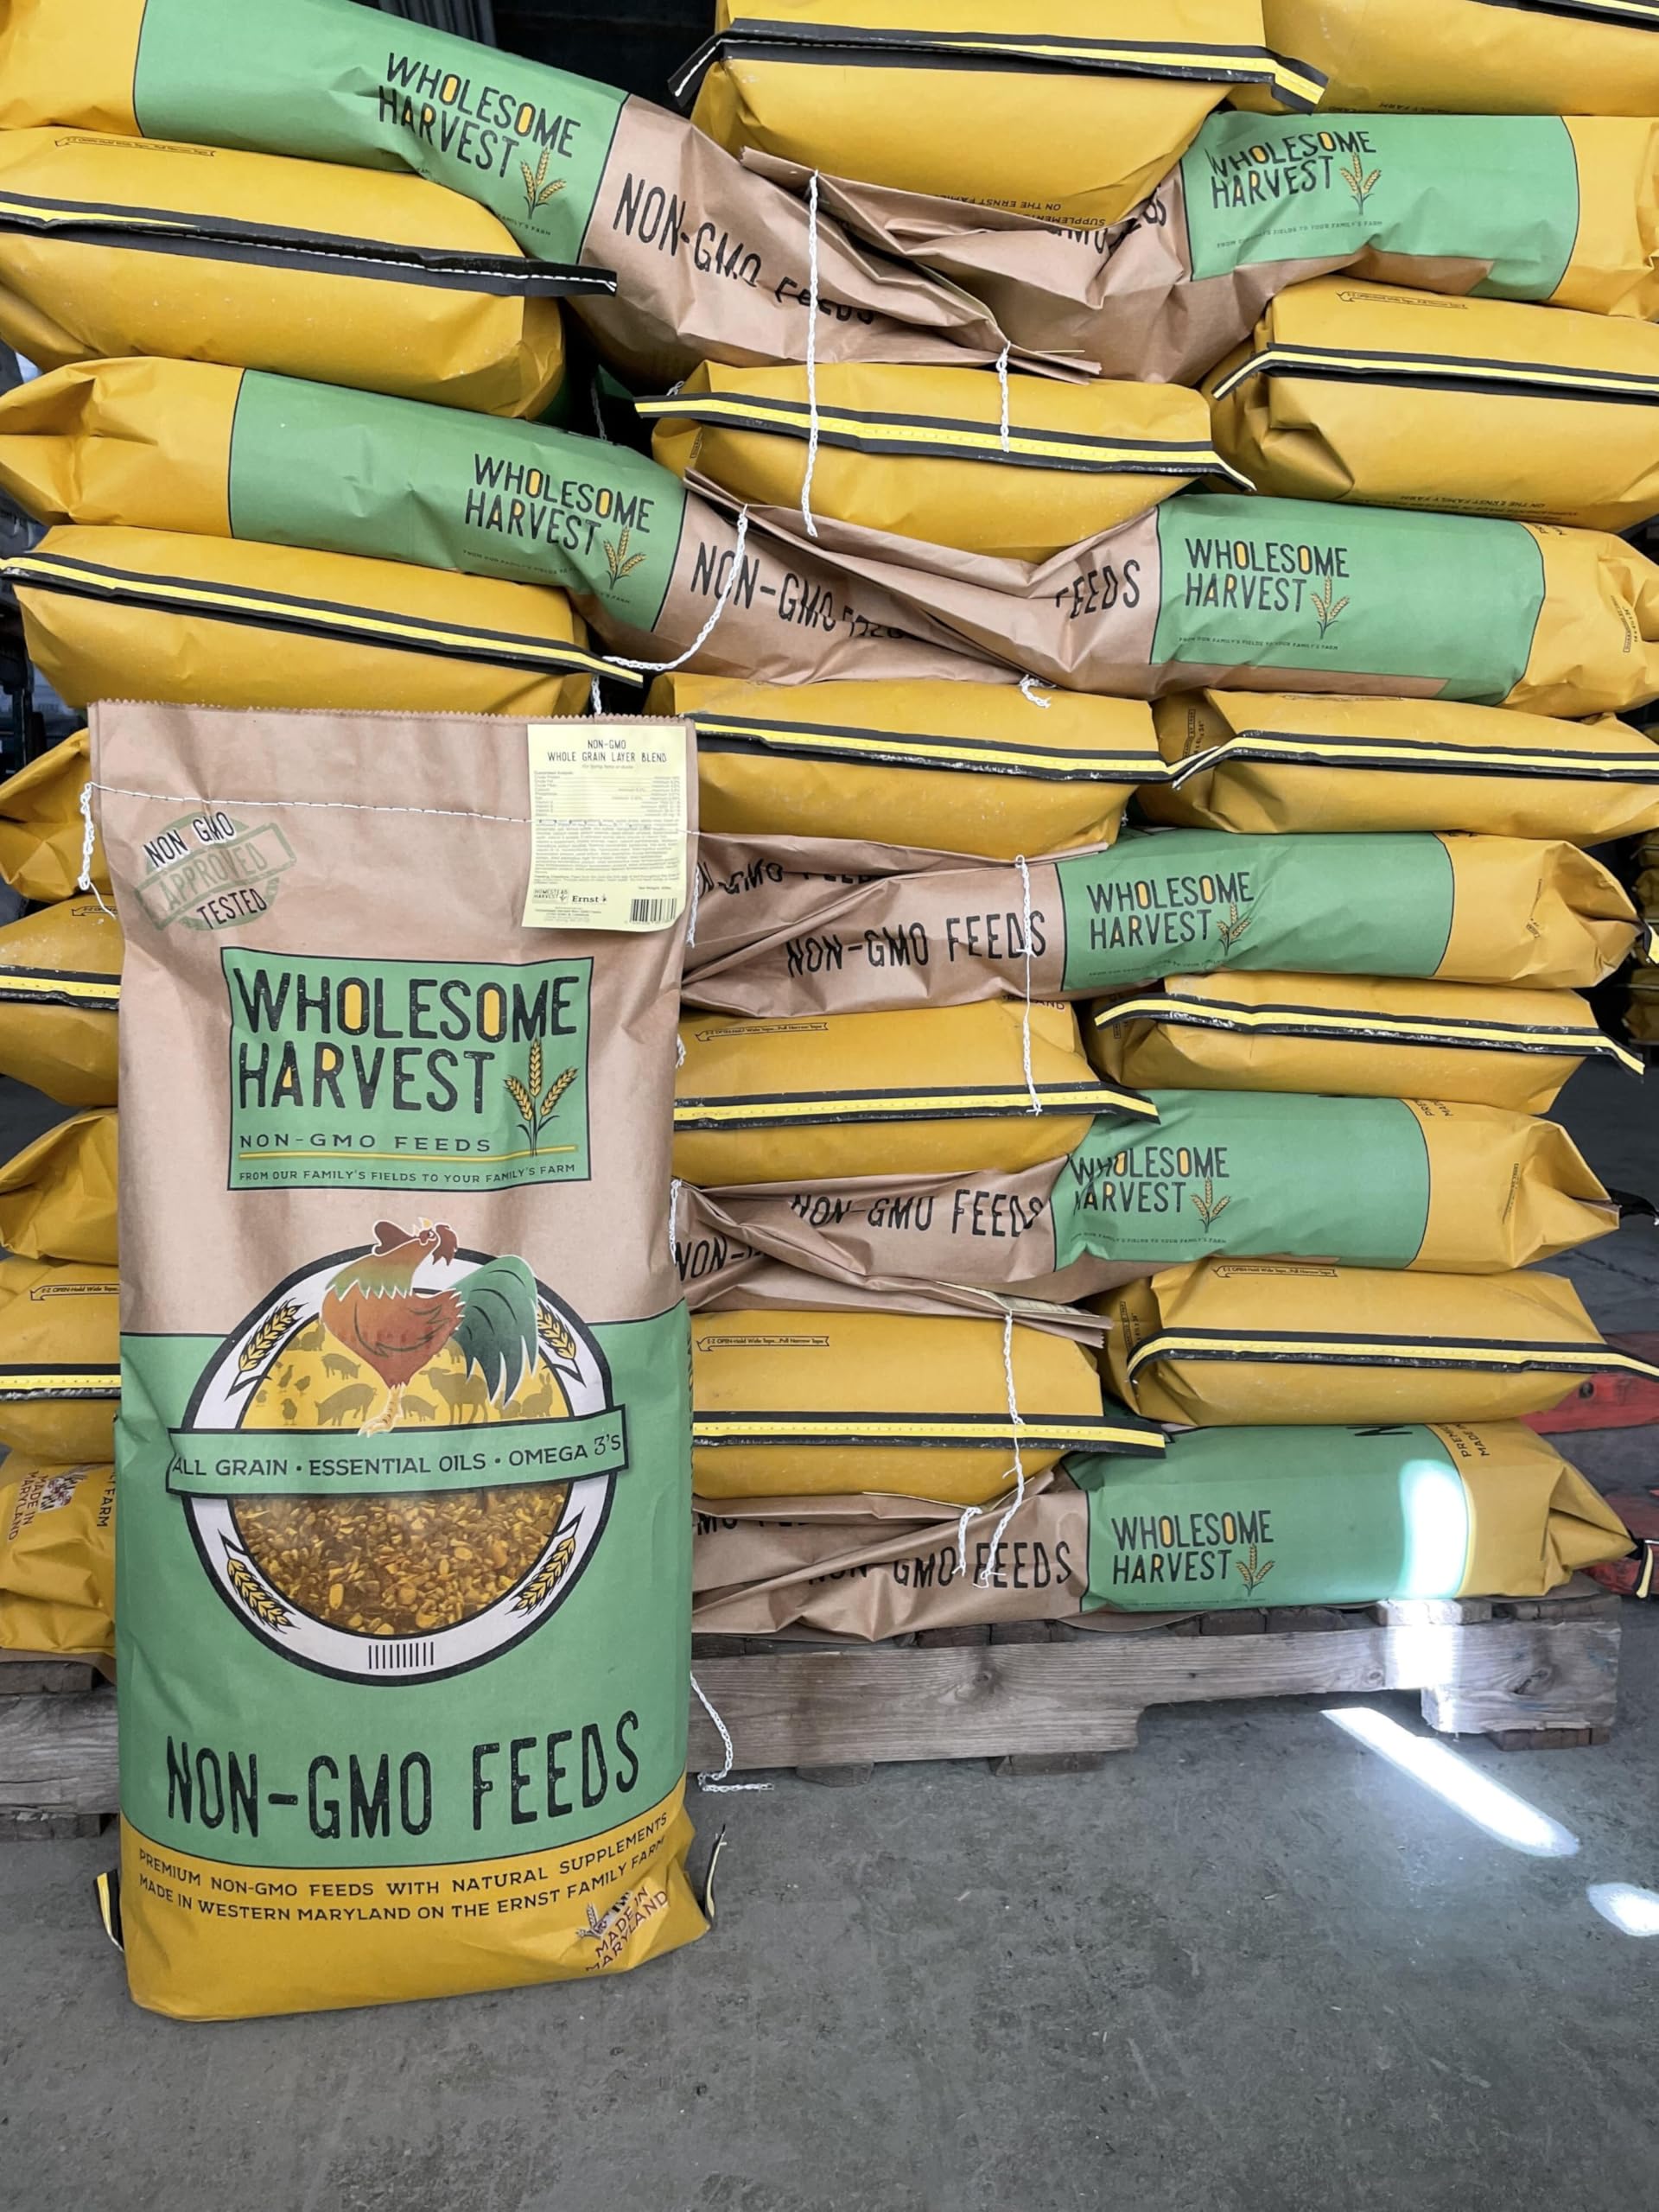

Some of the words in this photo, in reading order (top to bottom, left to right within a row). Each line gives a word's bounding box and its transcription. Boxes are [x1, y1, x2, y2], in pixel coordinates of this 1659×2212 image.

[387, 53, 581, 158] WHOLESOME
[378, 85, 519, 178] HARVEST
[1204, 131, 1376, 177] WHOLESOME
[1211, 156, 1333, 209] HARVEST
[1020, 201, 1042, 211] THE
[474, 454, 654, 533] WHOLESOME
[465, 488, 601, 556] HARVEST
[1185, 537, 1350, 578] WHOLESOME
[1185, 572, 1307, 613] HARVEST
[547, 751, 576, 762] WHOLE
[582, 752, 606, 761] GRAIN
[611, 752, 636, 762] LAYER
[641, 753, 667, 762] BLEND
[588, 740, 626, 749] NON-GMO
[143, 829, 188, 868] NON
[192, 811, 235, 842] GMO
[159, 842, 269, 911] APPROVED
[1086, 872, 1255, 914] WHOLESOME
[196, 888, 268, 930] TESTED
[1090, 909, 1211, 950] HARVEST
[785, 922, 930, 978] NON-GMO
[946, 910, 1046, 962] FEEDS
[232, 967, 580, 1043] WHOLESOME
[238, 1040, 496, 1115] HARVEST
[239, 1133, 376, 1149] NON-GMO
[394, 1135, 492, 1153] FEEDS
[239, 1170, 269, 1181] FROM
[272, 1169, 298, 1180] OUR
[303, 1169, 366, 1181] FAMILY'S
[372, 1172, 416, 1183] FIELDS
[423, 1173, 439, 1183] TO
[444, 1173, 482, 1184] YOUR
[486, 1166, 536, 1184] FAMILY'S
[540, 1163, 575, 1176] FARM
[1068, 1147, 1230, 1186] WHOLESOME
[172, 1457, 207, 1477] ALL
[215, 1458, 288, 1477] GRAIN
[309, 1457, 431, 1477] ESSENTIAL
[439, 1452, 486, 1472] OILS
[508, 1445, 588, 1467] OMEGA
[594, 1433, 621, 1457] 3'S
[8, 1471, 39, 1541] MARYLAND
[27, 1474, 49, 1510] MADE
[97, 1488, 116, 1528] FARM
[22, 1511, 35, 1526] IN
[1111, 1510, 1274, 1551] WHOLESOME
[976, 1541, 1072, 1589] FEEDS
[1113, 1549, 1232, 1585] HARVEST
[166, 1733, 432, 1840] NON-GMO
[472, 1709, 639, 1831] FEEDS
[139, 1847, 200, 1886] PREMIUM
[211, 1876, 297, 1897] NON-GMO
[309, 1882, 373, 1897] FEEDS
[387, 1881, 440, 1896] WITH
[452, 1867, 549, 1893] NATURAL
[559, 1812, 668, 1875] SUPPLEMENTS
[139, 1872, 174, 1904] MADE
[177, 1892, 192, 1910] IN
[197, 1899, 290, 1921] WESTERN
[297, 1906, 410, 1921] MARYLAND
[417, 1905, 444, 1920] ON
[452, 1902, 490, 1918] THE
[497, 1889, 560, 1913] ERNST
[567, 1862, 627, 1899] FAMILY
[631, 1835, 665, 1869] FARM
[585, 1891, 668, 1971] MARYLAND
[594, 1906, 633, 1958] MADE
[634, 1886, 649, 1907] IN
